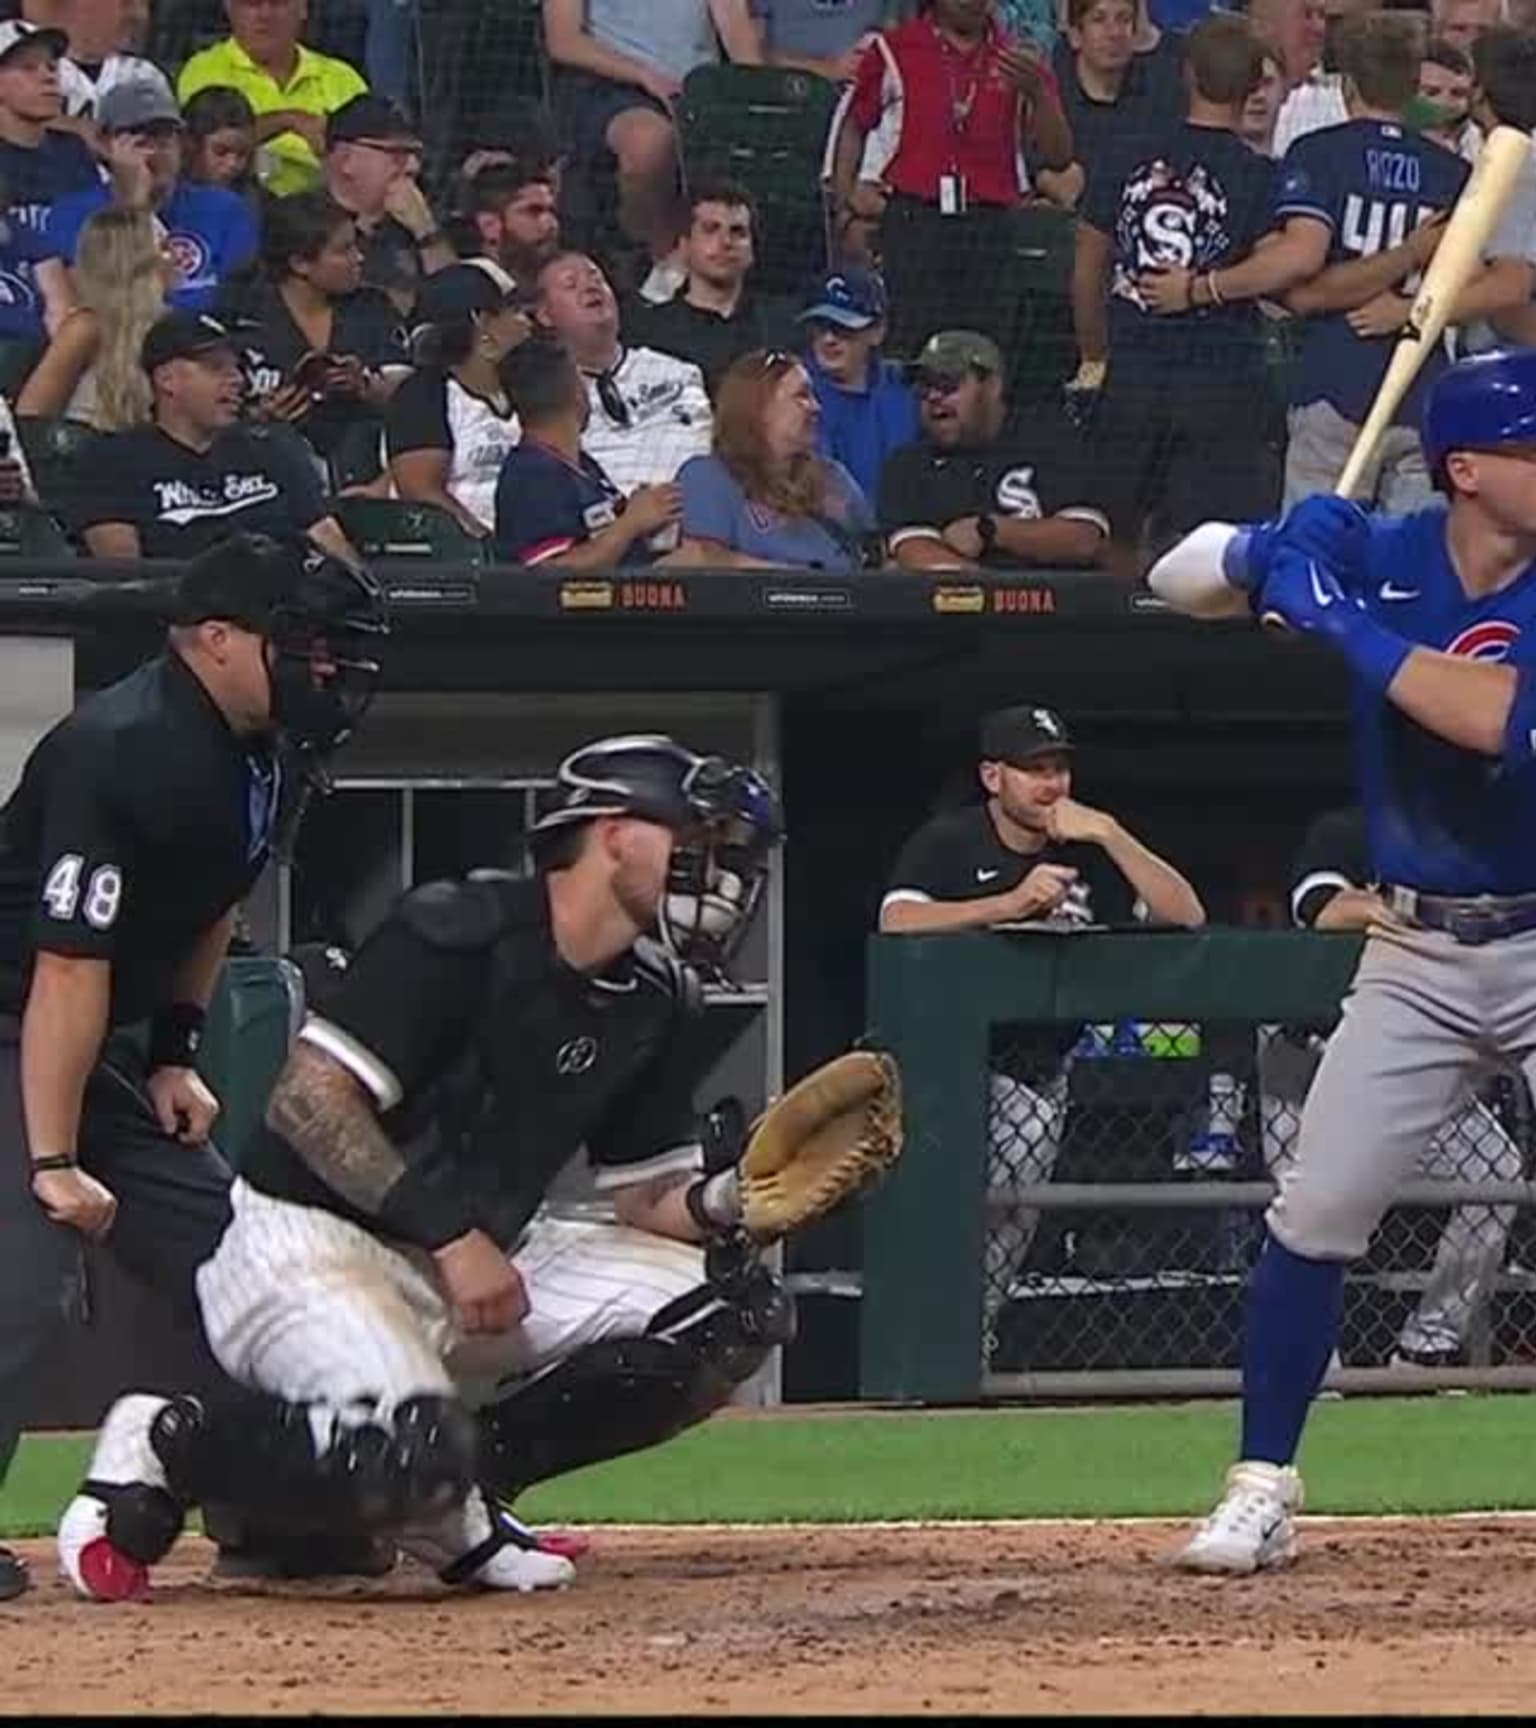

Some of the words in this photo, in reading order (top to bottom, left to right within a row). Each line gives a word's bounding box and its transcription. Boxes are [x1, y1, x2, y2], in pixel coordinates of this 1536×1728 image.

[622, 585, 686, 608] BUONA
[993, 589, 1055, 612] BUONA
[42, 852, 122, 931] 48
